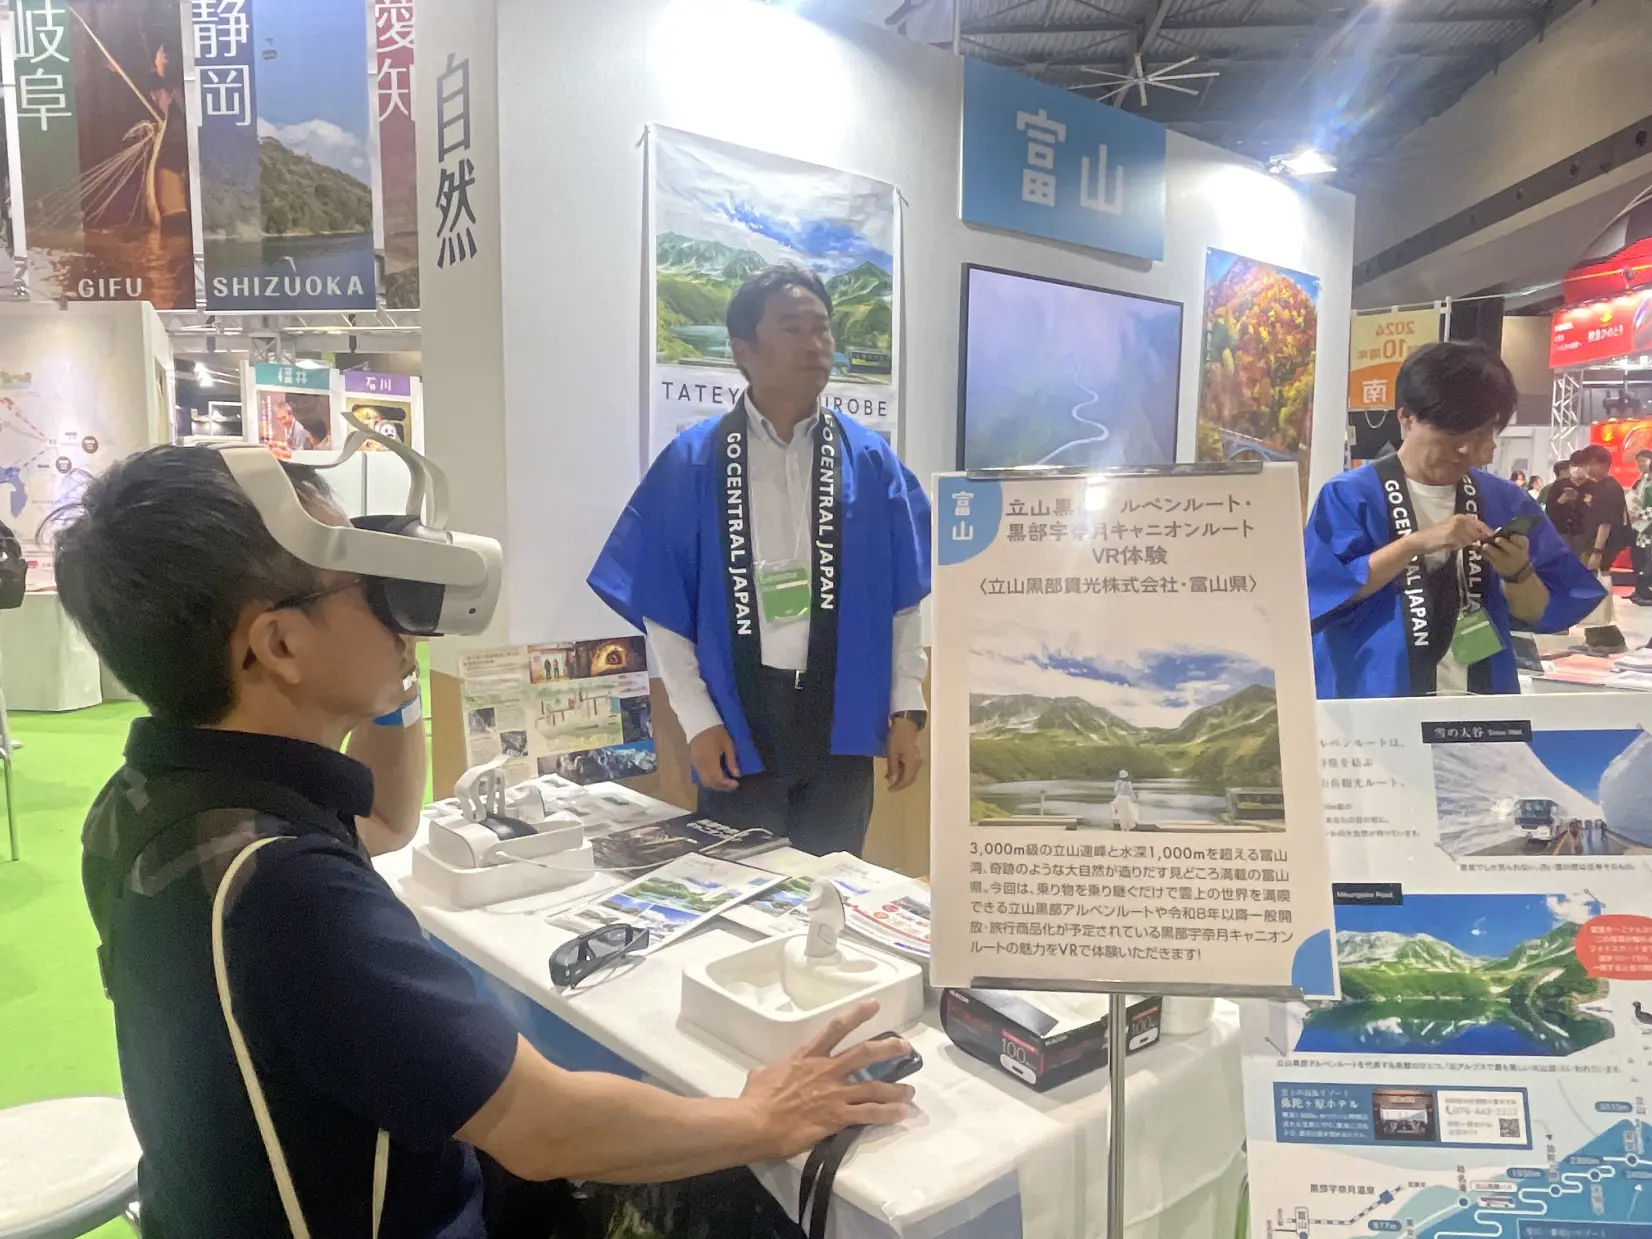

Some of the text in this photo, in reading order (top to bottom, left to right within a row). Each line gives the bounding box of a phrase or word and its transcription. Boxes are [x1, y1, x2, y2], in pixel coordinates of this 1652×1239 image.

[14, 0, 72, 131] 岐阜
[192, 0, 251, 127] 静岡
[436, 53, 477, 269] 自然
[1016, 109, 1124, 215] 富山
[77, 278, 143, 299] GIFU
[212, 275, 364, 297] SHIZUOKA
[365, 376, 392, 392] 石川
[661, 381, 888, 417] TATEY ROBE
[818, 442, 836, 536] CENTRAL
[1005, 495, 1252, 517] 立山黒ルペンルート・
[726, 432, 752, 635] GO CENTRAL JAPAN
[951, 491, 975, 541] 富山
[816, 539, 834, 609] JAPAN
[1092, 545, 1168, 566] VR体験
[1384, 479, 1429, 647] GO CENAL JAPAN
[969, 842, 1288, 862] 3,000m級の立山連峰と水深1,000mを超える富山
[1130, 1015, 1151, 1035] 100
[1000, 1038, 1027, 1065] 100
